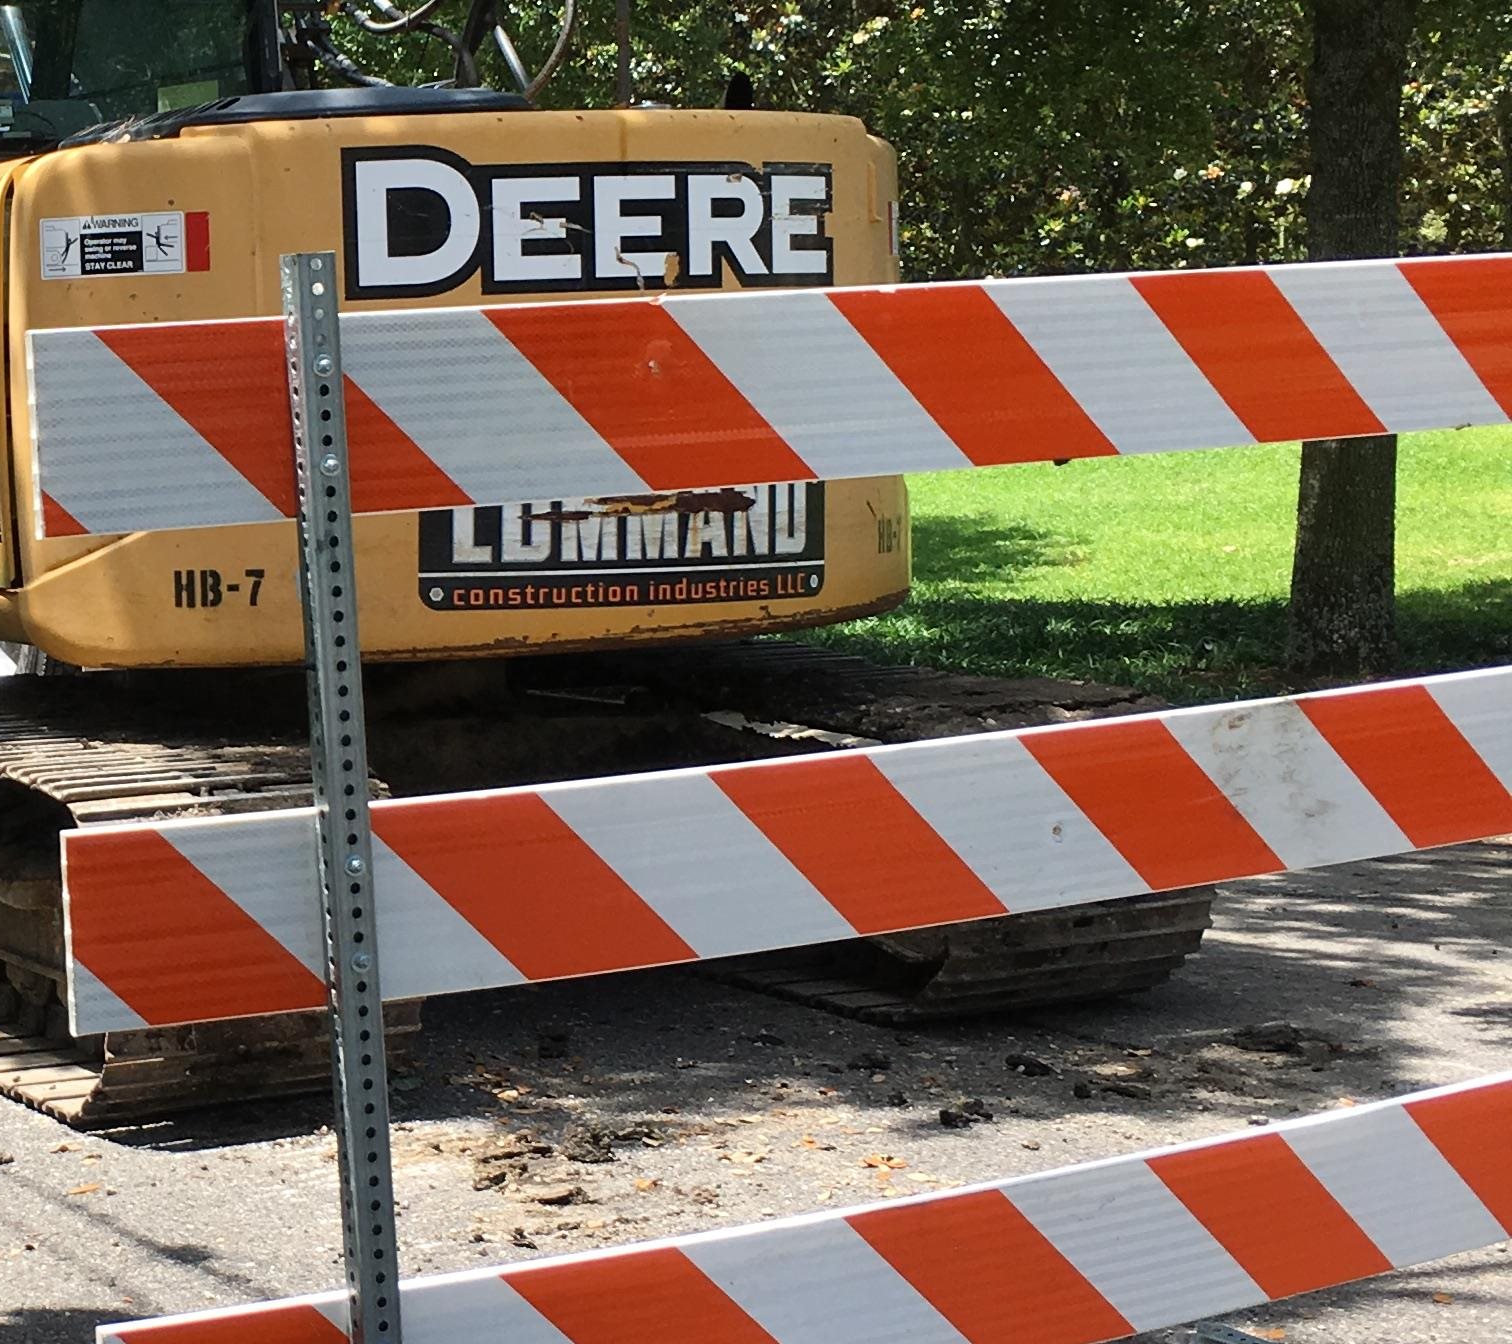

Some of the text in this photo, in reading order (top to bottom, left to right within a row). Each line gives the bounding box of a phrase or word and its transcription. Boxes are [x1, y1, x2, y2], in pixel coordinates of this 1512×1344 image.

[92, 217, 139, 229] WARNING
[355, 158, 828, 288] DEERE
[85, 260, 133, 270] STAY CLEAR
[174, 569, 265, 608] HB-7
[453, 573, 805, 605] construction industries LLC
